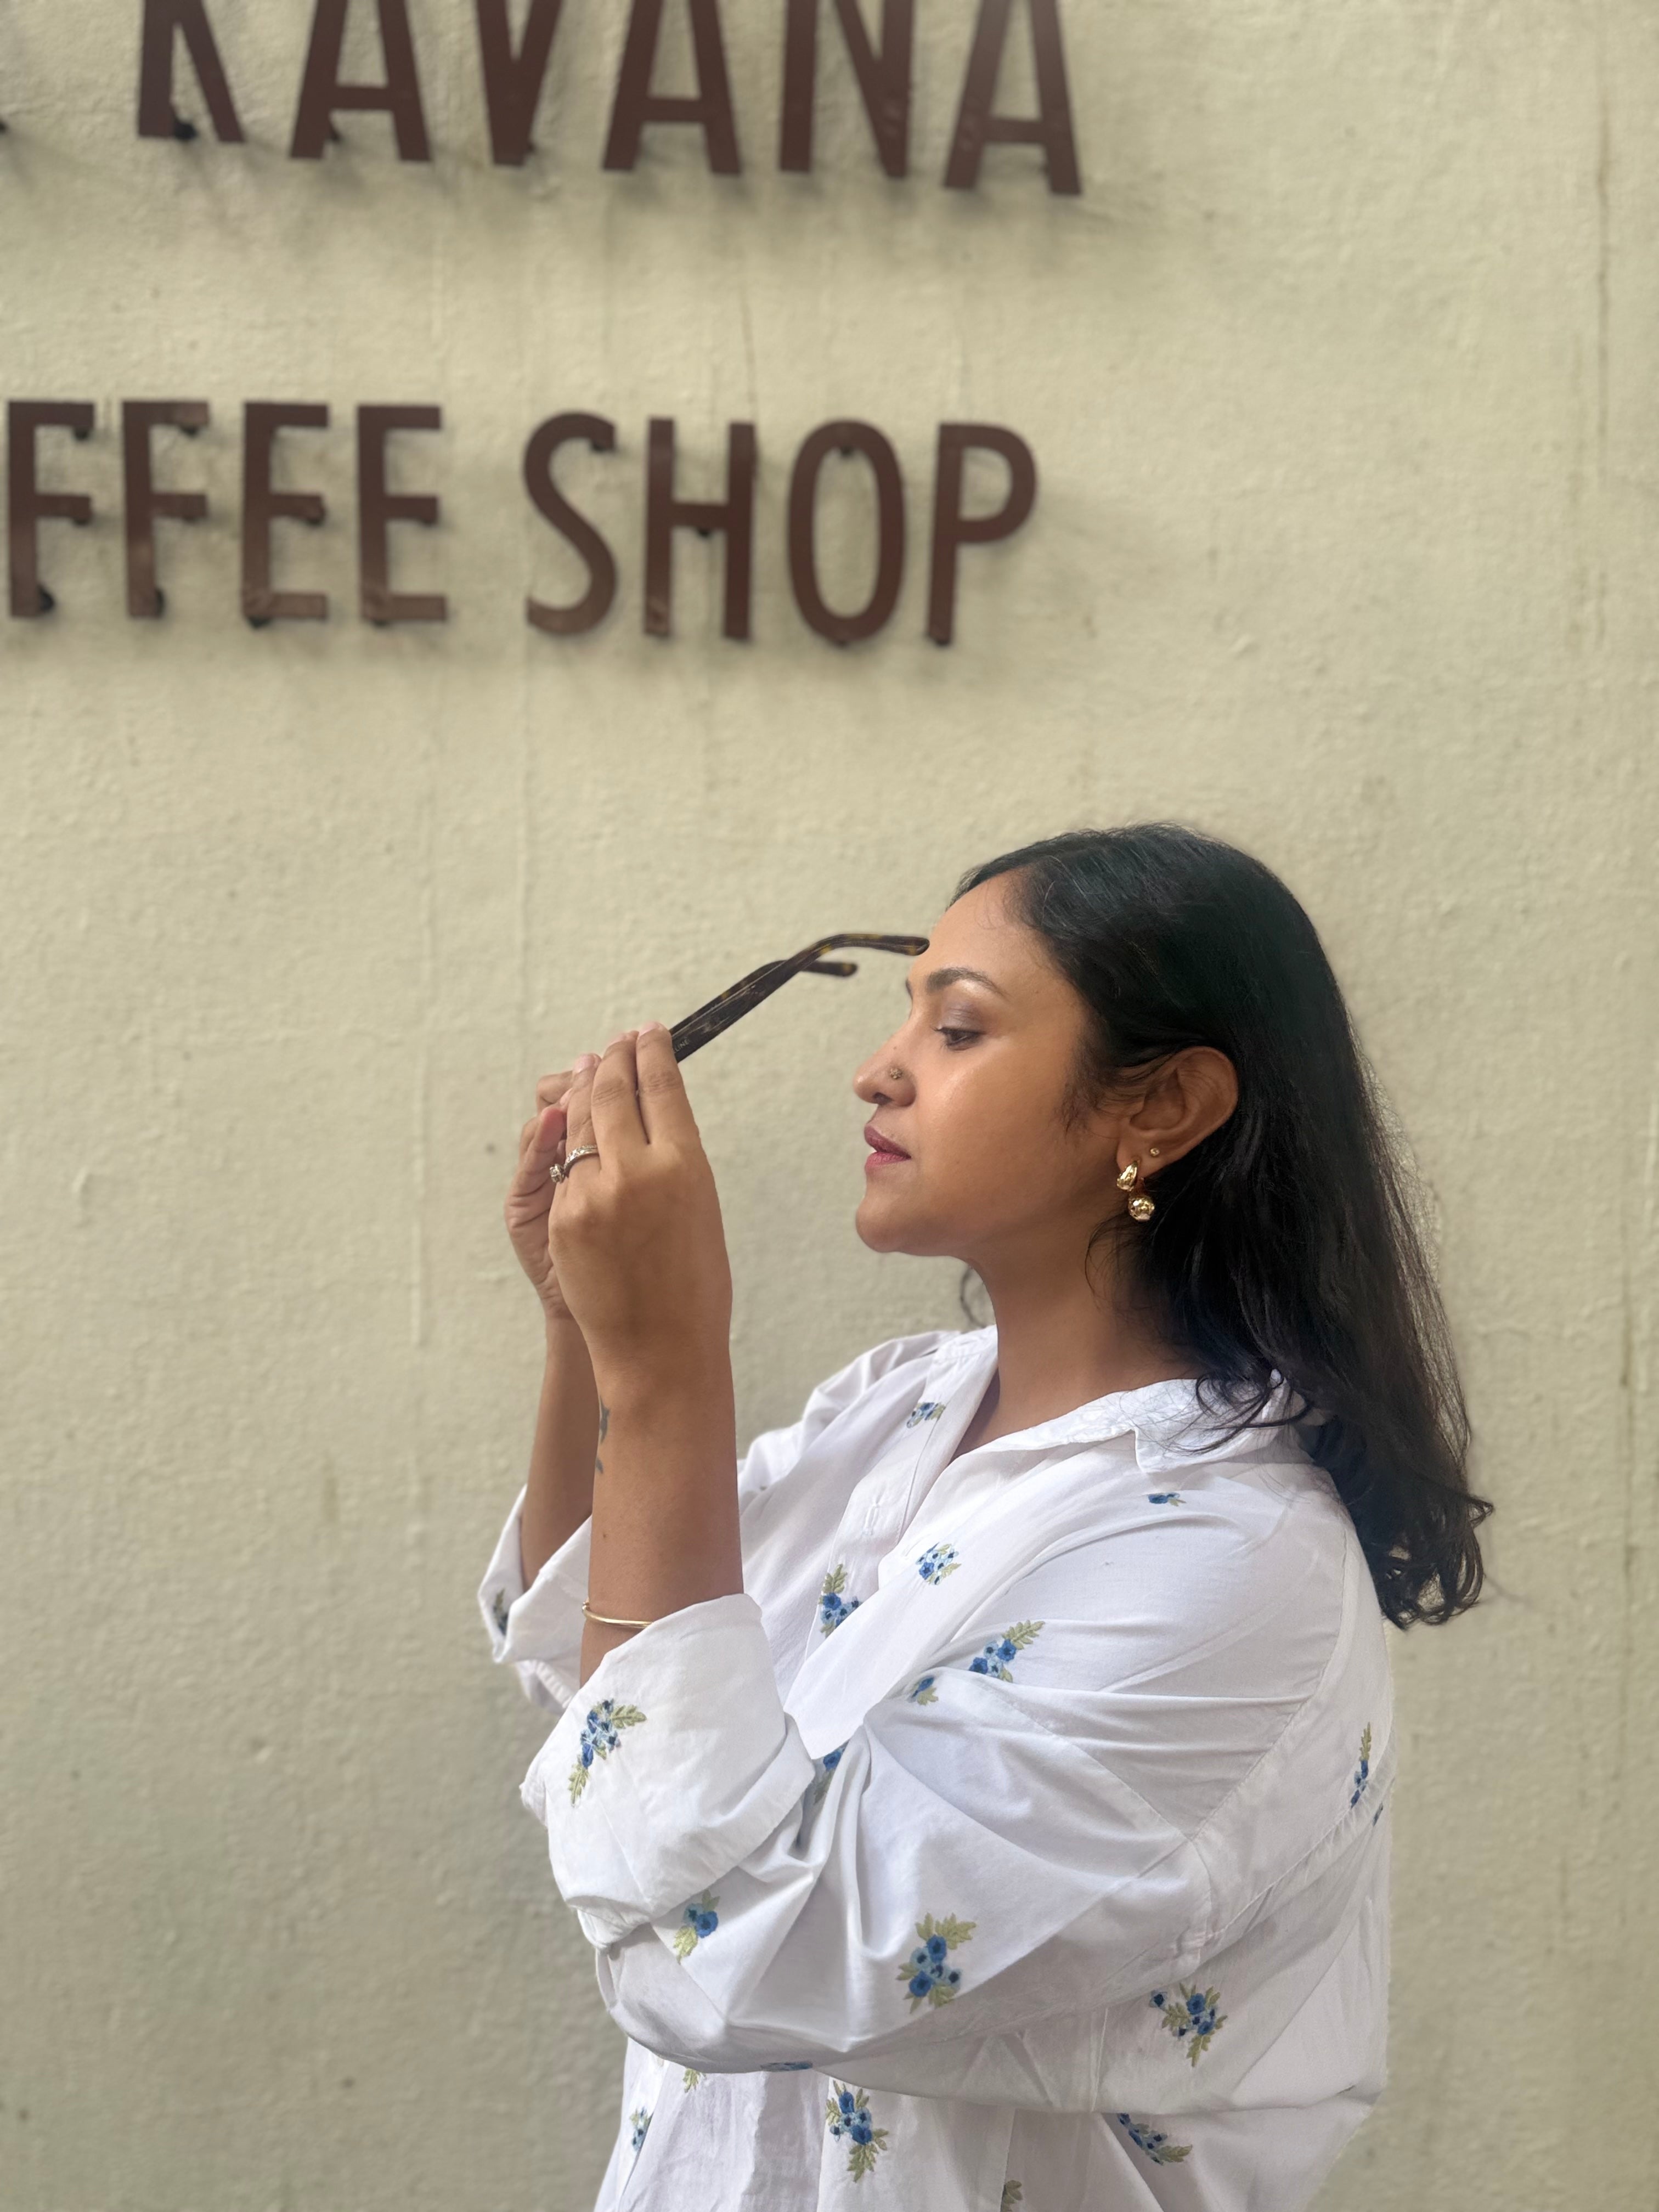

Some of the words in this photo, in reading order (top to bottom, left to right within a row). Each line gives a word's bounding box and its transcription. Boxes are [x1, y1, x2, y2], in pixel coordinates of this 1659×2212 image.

[8, 401, 447, 625] FFEE
[523, 413, 1038, 645] SHOP
[674, 1039, 690, 1053] LINE
